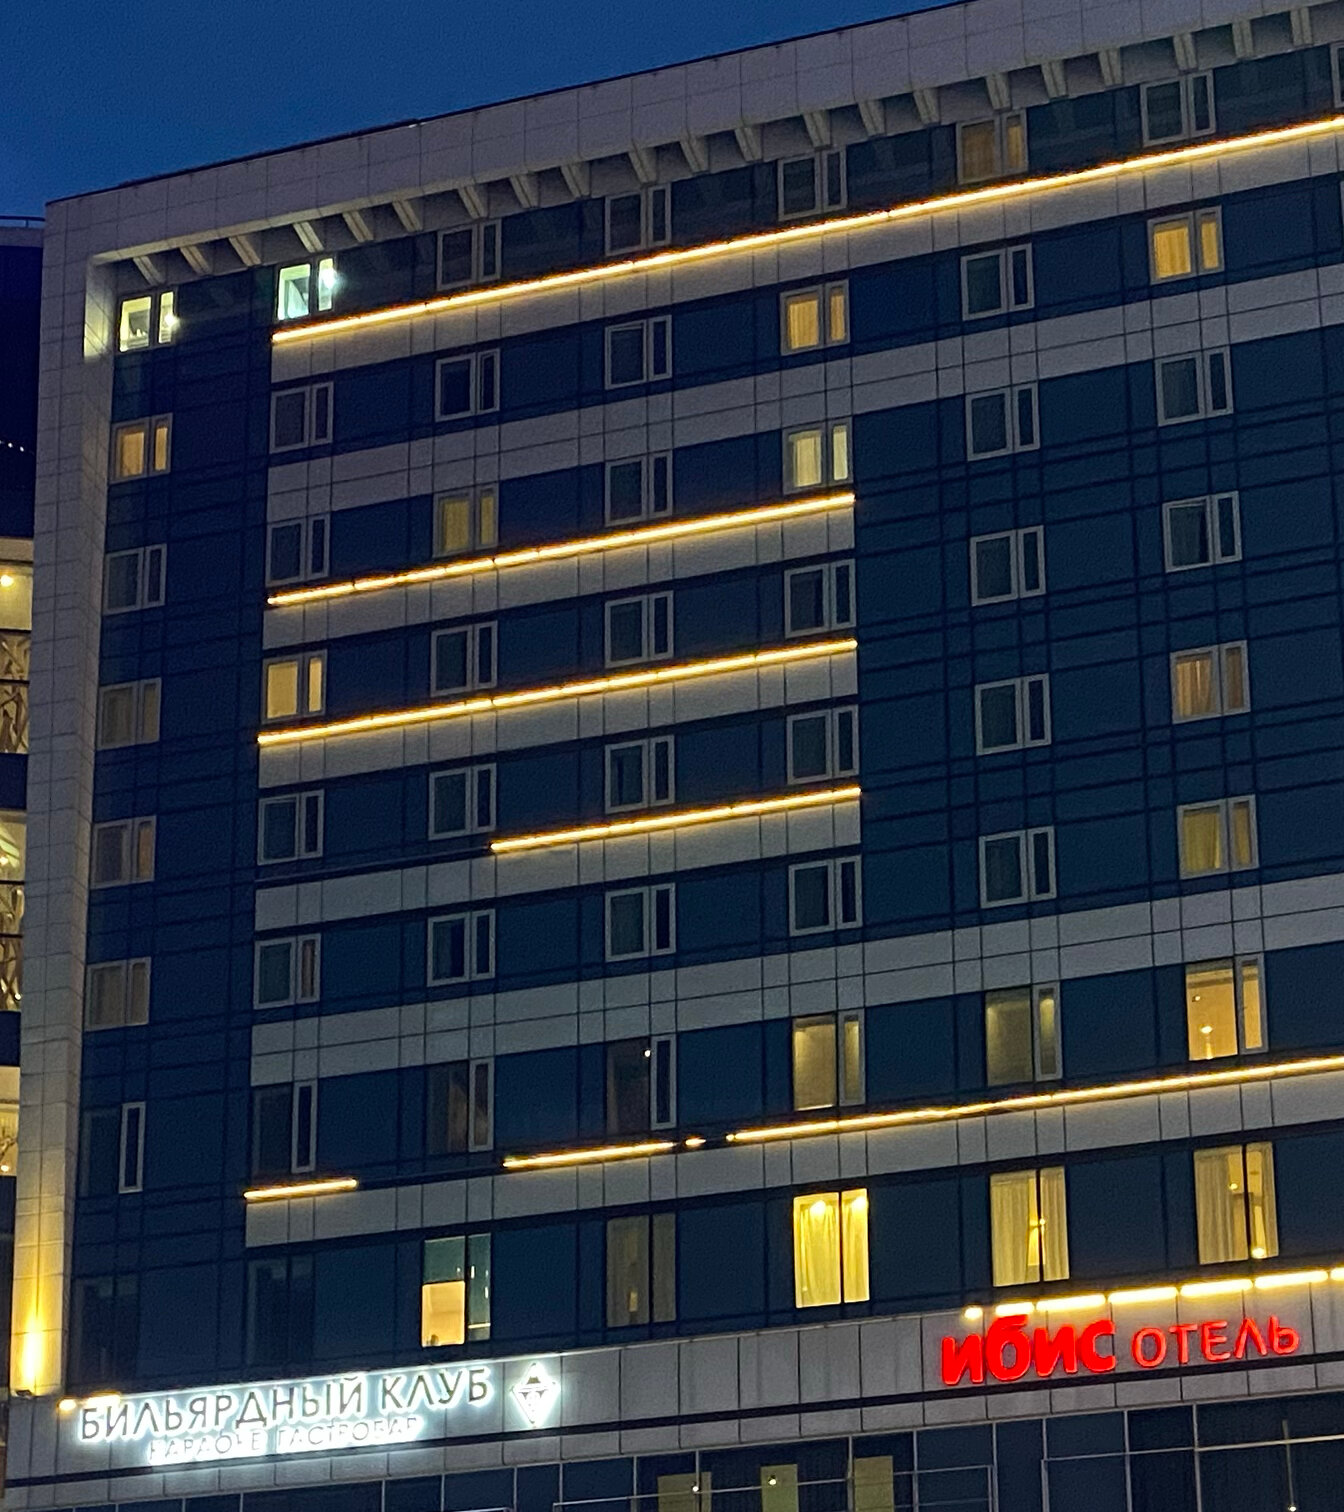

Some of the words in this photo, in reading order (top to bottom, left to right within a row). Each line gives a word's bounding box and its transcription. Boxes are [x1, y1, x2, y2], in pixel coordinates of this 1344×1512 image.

[1131, 1315, 1300, 1368] ОТЕЛЬ
[80, 1374, 363, 1440] БИЛЬЯРДНЫЙ
[382, 1367, 489, 1411] КЛУБ
